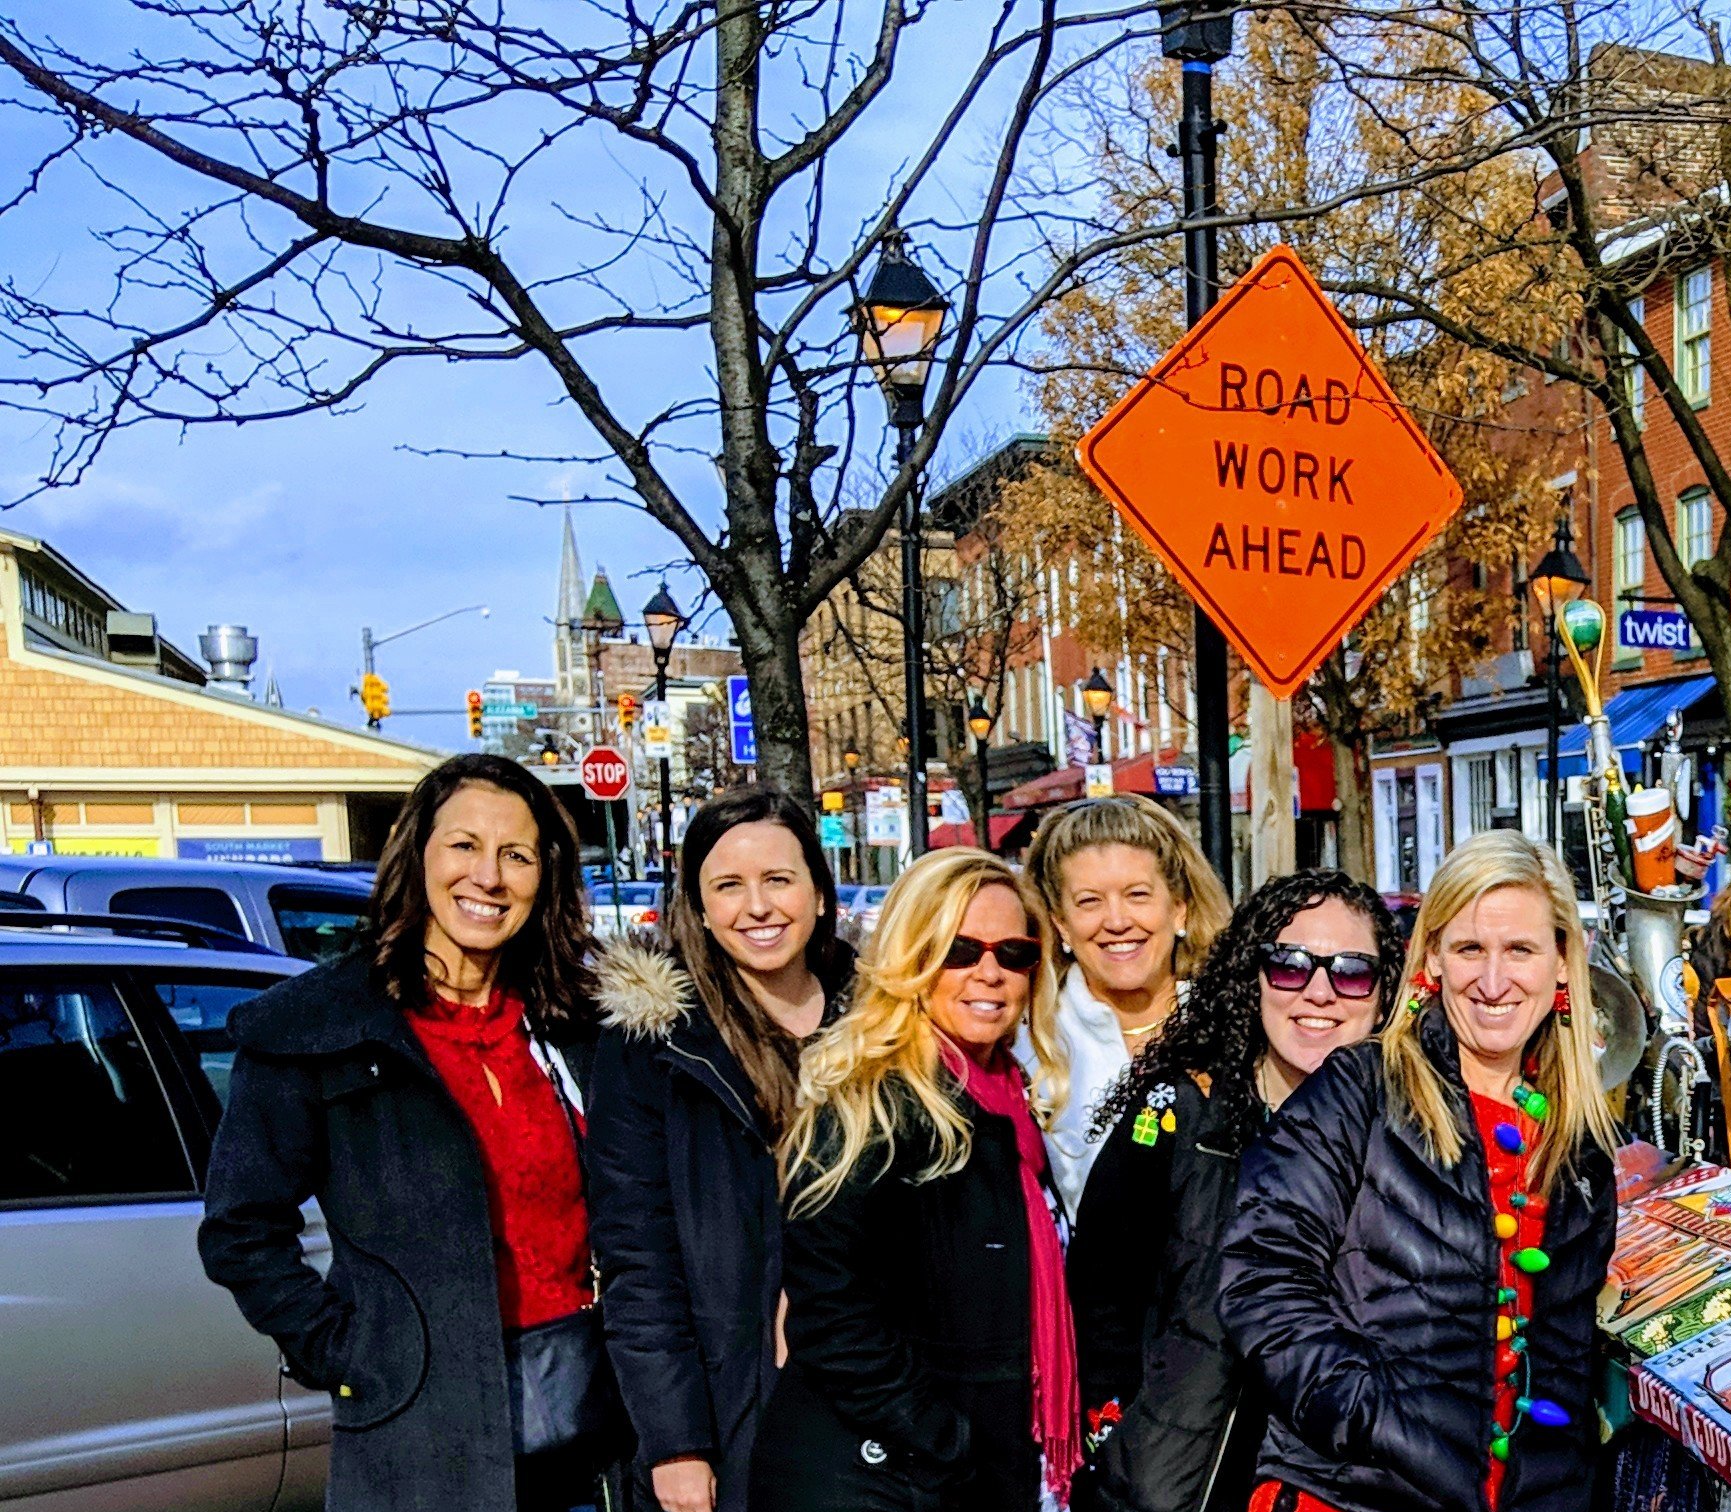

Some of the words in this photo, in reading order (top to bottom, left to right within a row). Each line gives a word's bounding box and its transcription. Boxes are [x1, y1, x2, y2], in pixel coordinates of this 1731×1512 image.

[1220, 362, 1350, 426] ROAD
[1214, 439, 1354, 505] WORK
[1203, 522, 1366, 580] AHEAD
[1624, 615, 1686, 646] twist
[584, 762, 625, 784] STOP
